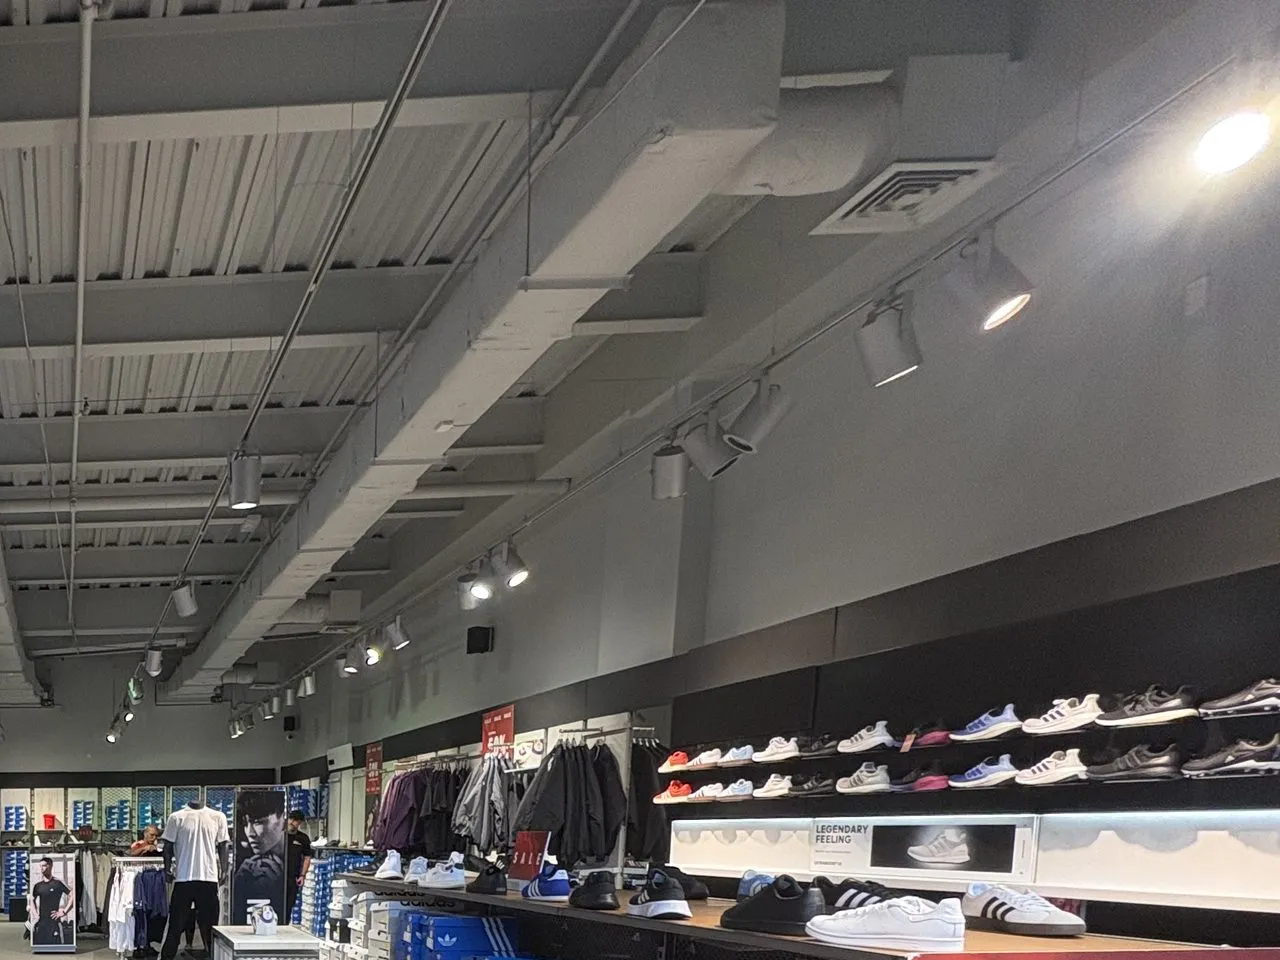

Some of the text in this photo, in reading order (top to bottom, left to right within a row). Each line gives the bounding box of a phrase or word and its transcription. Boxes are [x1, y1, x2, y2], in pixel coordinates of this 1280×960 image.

[816, 824, 869, 834] LEGENDARY
[815, 835, 852, 844] FEELING
[513, 851, 542, 865] SALE
